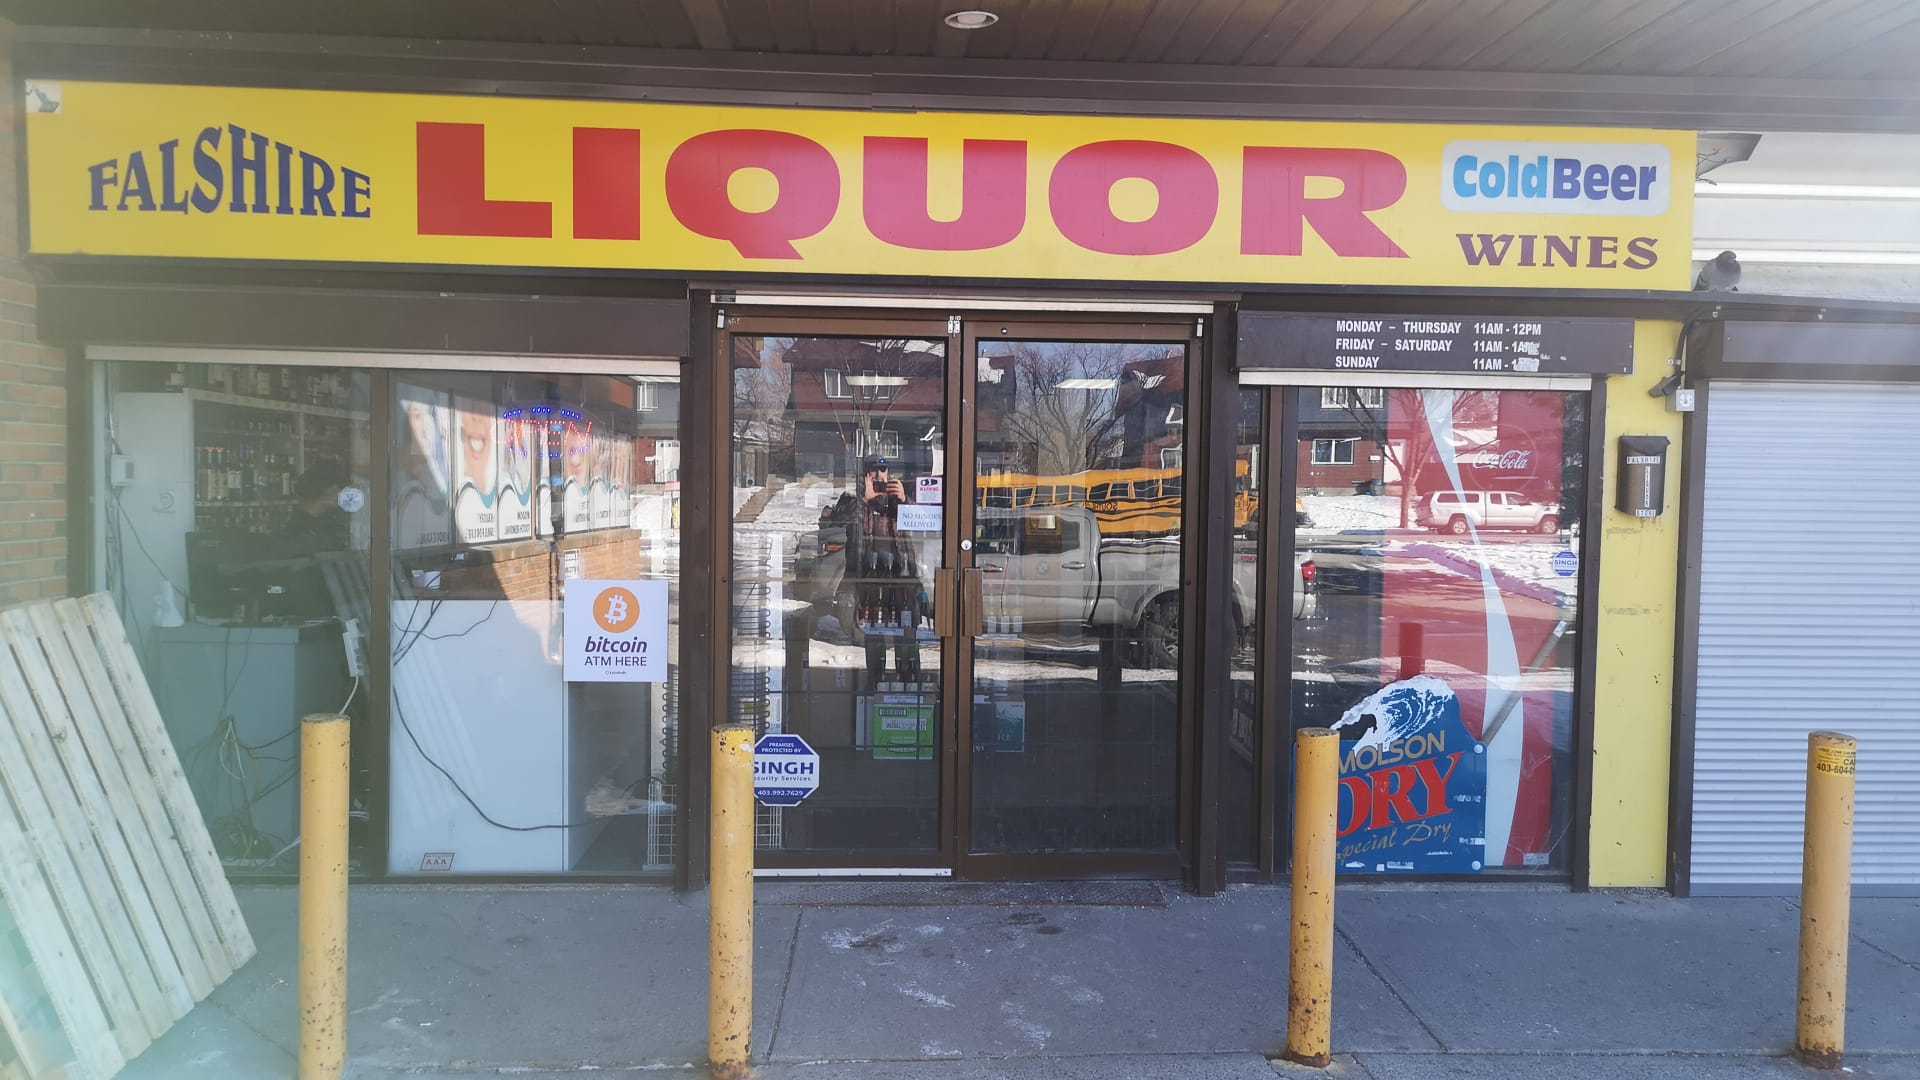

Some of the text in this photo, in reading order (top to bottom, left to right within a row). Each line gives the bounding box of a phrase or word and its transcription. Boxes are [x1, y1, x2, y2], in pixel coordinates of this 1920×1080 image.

[87, 122, 371, 218] FALSHIRE
[416, 121, 1411, 260] LIQUOR
[1455, 233, 1659, 270] WINES
[1336, 320, 1383, 333] MONDAY
[1403, 321, 1462, 334] THURSDAY
[1473, 322, 1503, 335] 11AM
[1512, 323, 1542, 336] 12PM
[1335, 338, 1375, 350] FRIDAY
[1395, 339, 1453, 351] SATURDAY
[1472, 340, 1503, 353] 11AM
[1335, 356, 1380, 368] SUNDAY
[1472, 358, 1502, 370] 11AM
[585, 636, 647, 653] bitcoin
[584, 656, 647, 666] ATM HERE
[1339, 731, 1445, 773] MOLSON
[754, 761, 814, 774] SINGH
[1336, 752, 1466, 838] DRY
[1403, 821, 1452, 844] Dry
